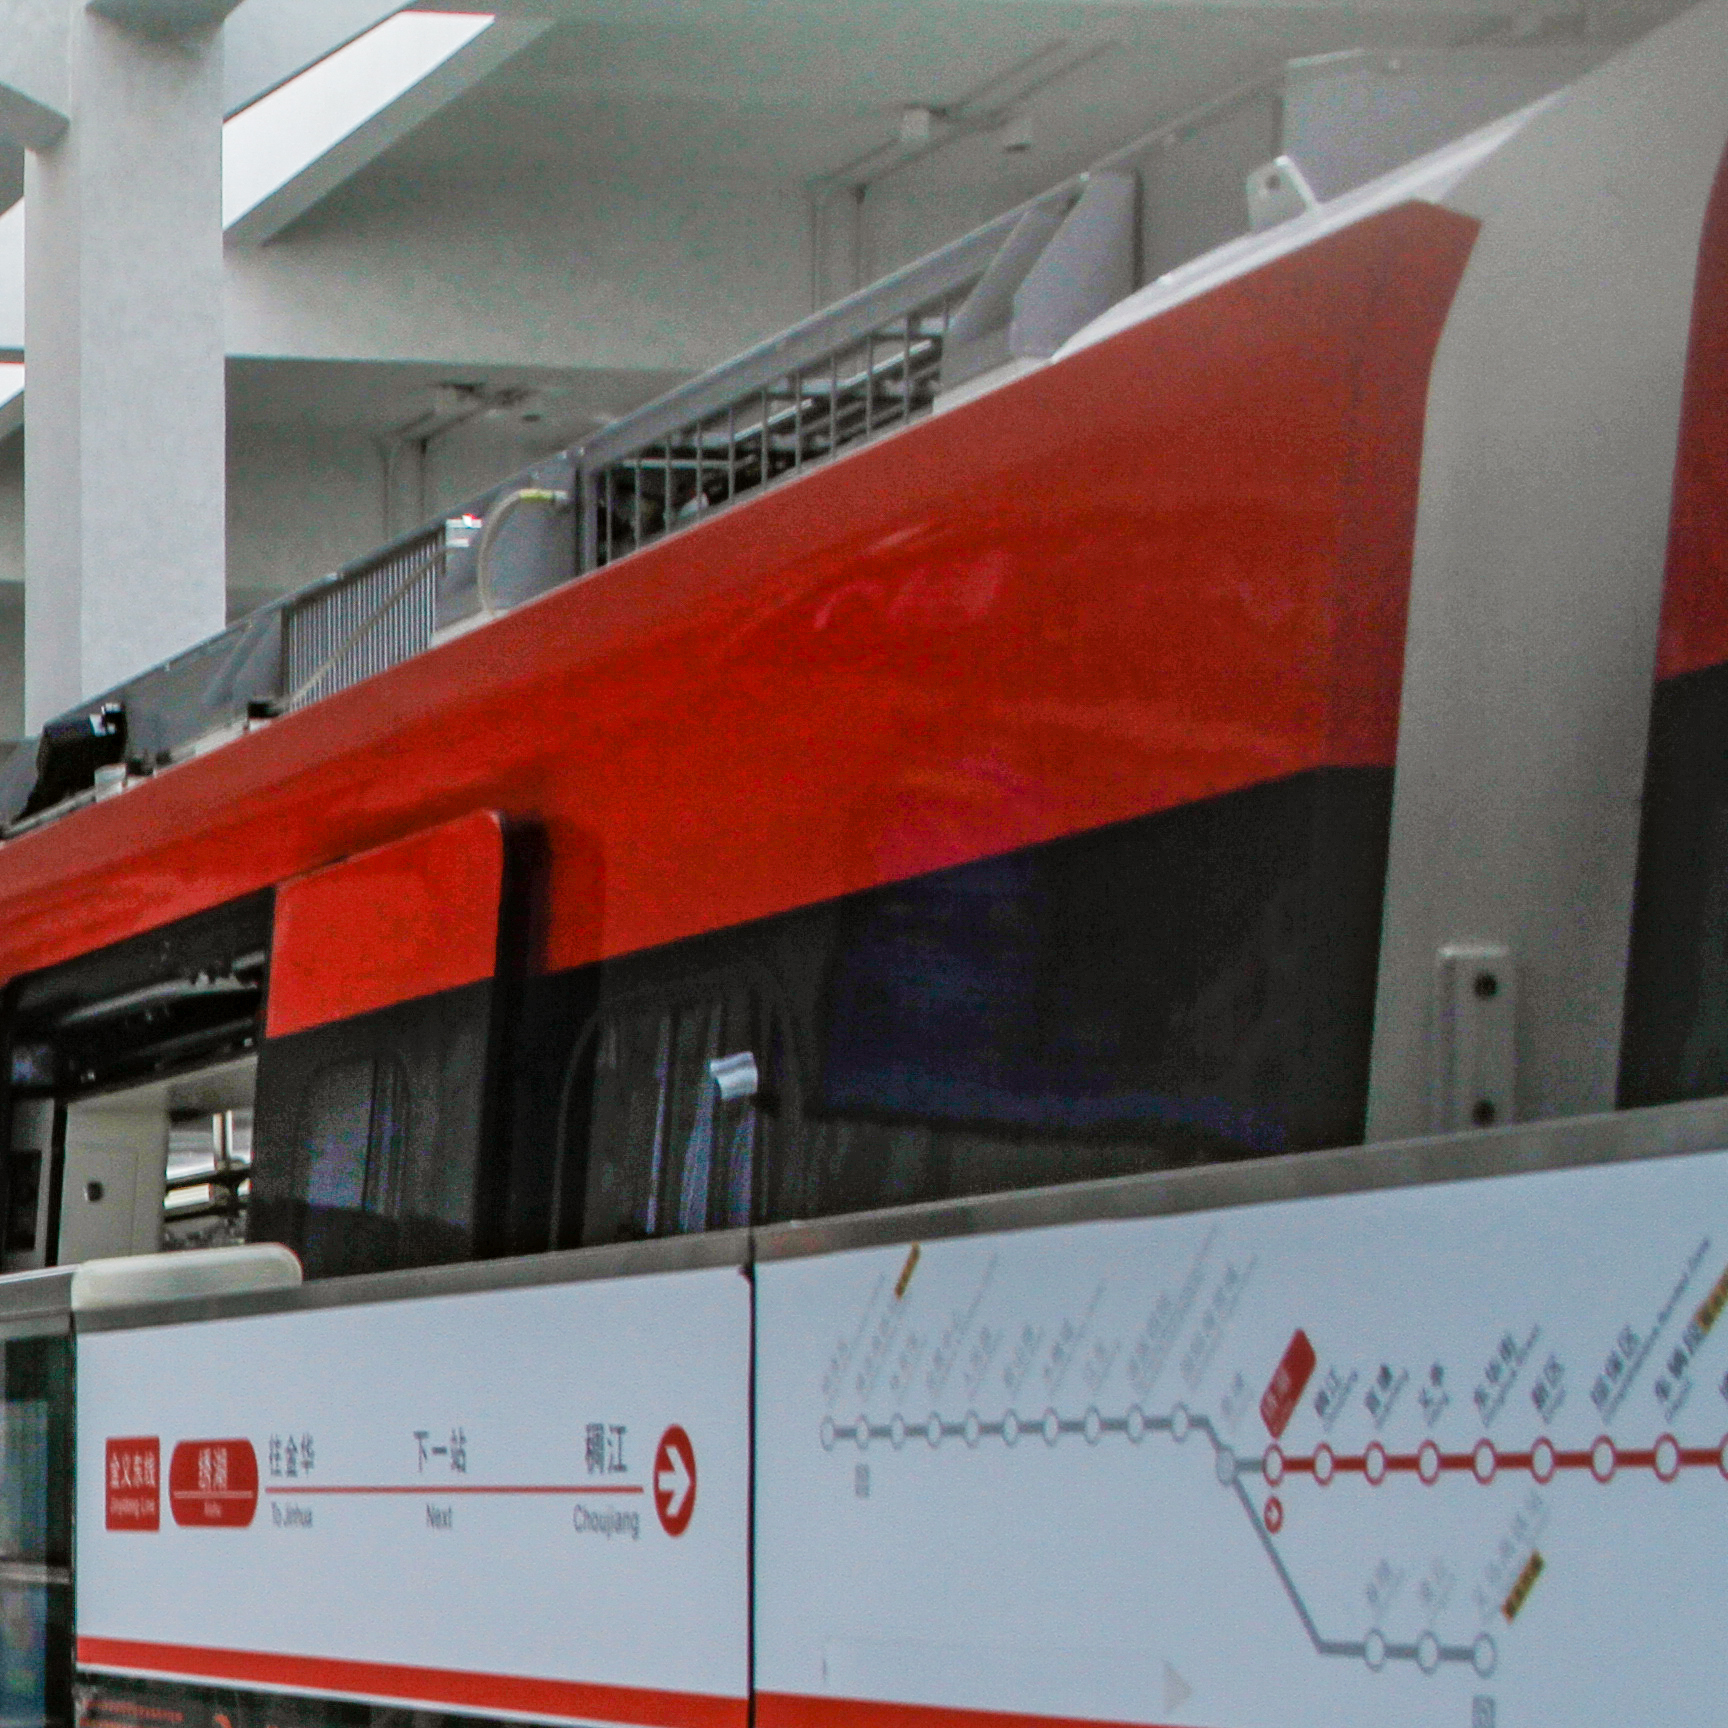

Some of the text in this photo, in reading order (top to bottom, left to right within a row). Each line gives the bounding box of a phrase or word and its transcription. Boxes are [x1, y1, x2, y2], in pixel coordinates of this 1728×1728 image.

[110, 1450, 156, 1489] 金义东线
[268, 1433, 315, 1478] 往金华
[413, 1426, 468, 1474] 下一站
[584, 1422, 628, 1475] 稠江
[425, 1504, 454, 1530] Next
[572, 1504, 641, 1541] Choujiang
